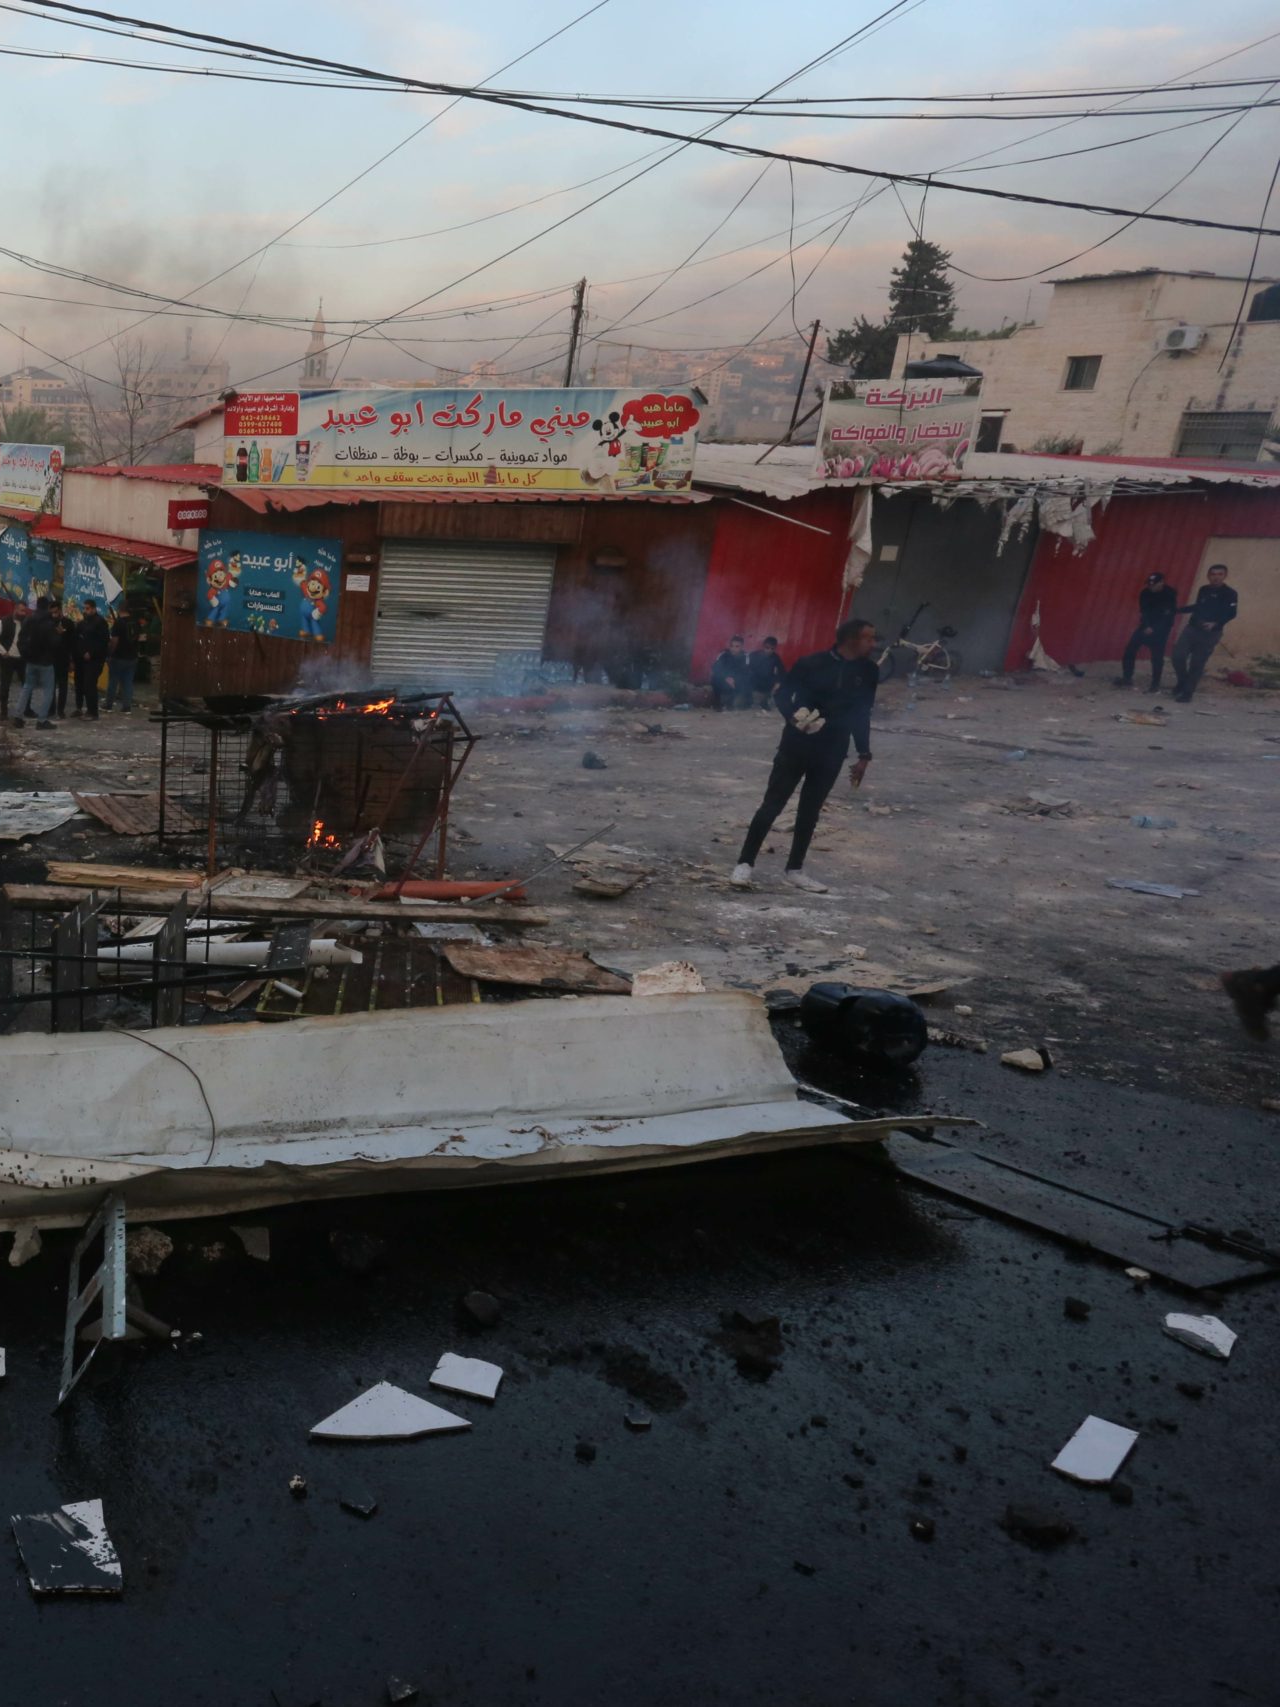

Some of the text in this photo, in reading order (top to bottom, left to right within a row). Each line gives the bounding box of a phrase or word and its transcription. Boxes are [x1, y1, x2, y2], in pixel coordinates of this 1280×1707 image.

[663, 401, 684, 413] ماما
[319, 393, 592, 442] ميني ماركت ابو عبيد
[831, 422, 964, 445] للخضار والفواكه
[334, 445, 378, 462] منظفات
[393, 445, 419, 463] بوظة
[434, 442, 484, 463] مكسرات
[499, 449, 539, 466] تموينية
[542, 447, 569, 466] مواد
[354, 471, 380, 485] واحد
[383, 471, 414, 484] سقف
[416, 472, 444, 484] تحت
[507, 472, 520, 484] ما
[522, 470, 543, 487] كل
[241, 552, 294, 573] أبو عبيد
